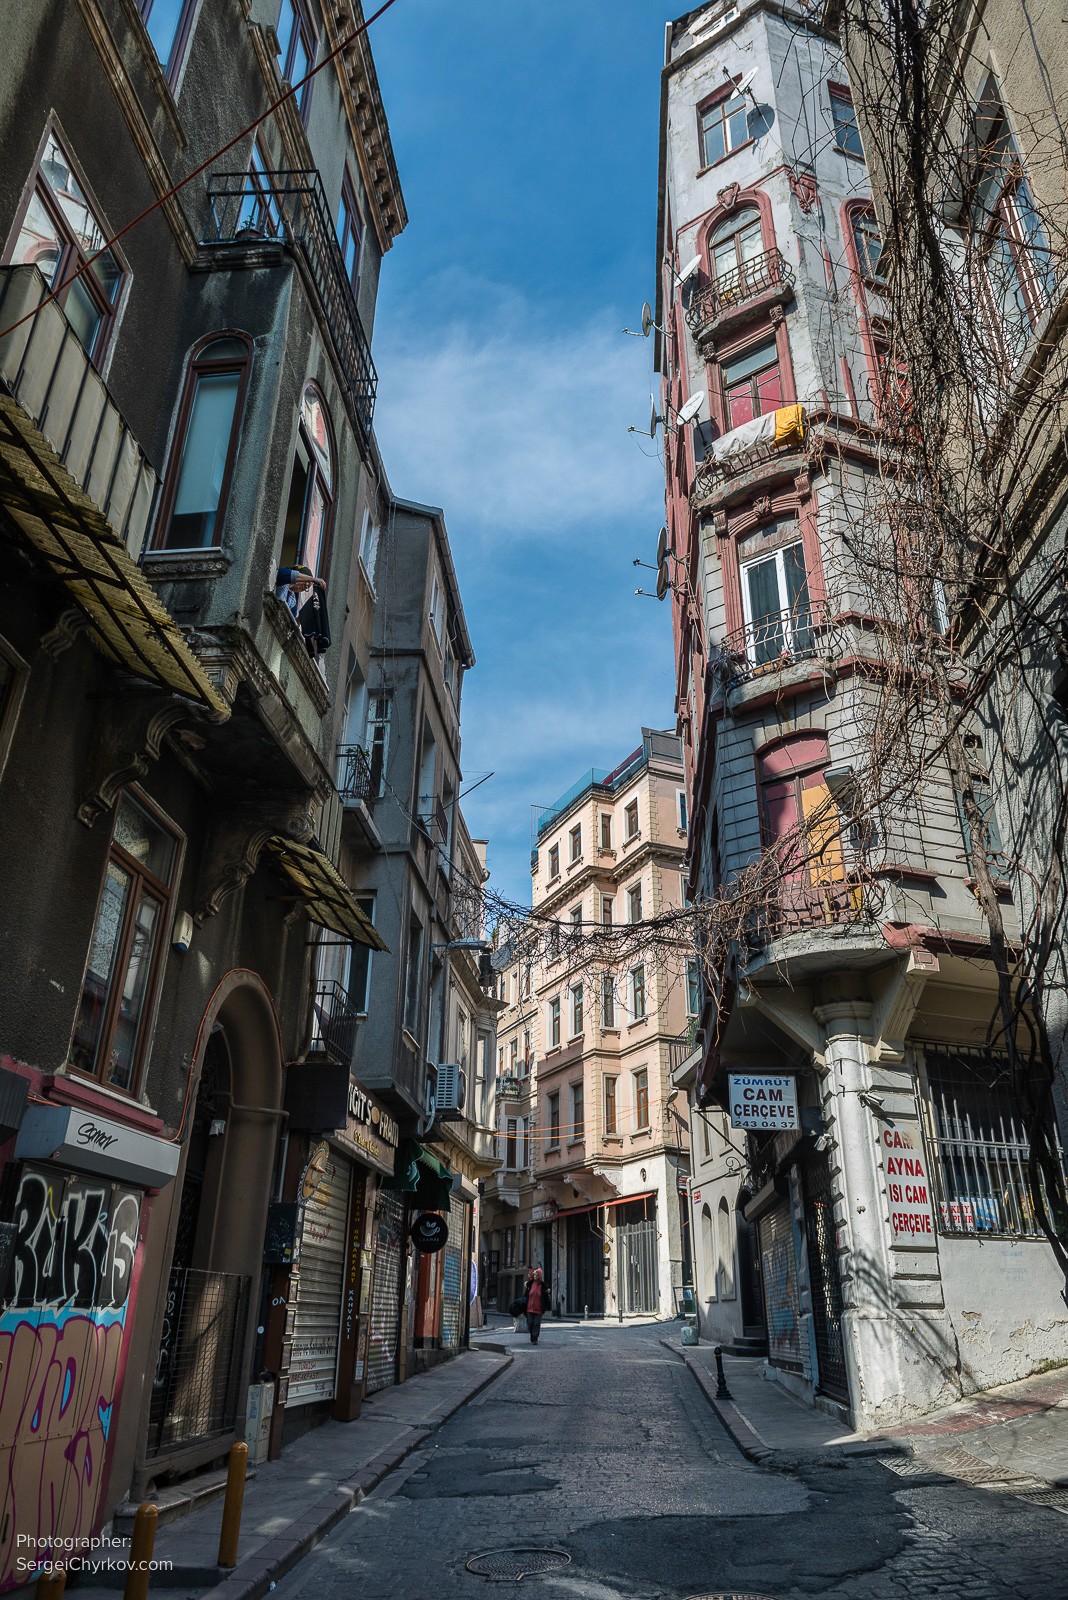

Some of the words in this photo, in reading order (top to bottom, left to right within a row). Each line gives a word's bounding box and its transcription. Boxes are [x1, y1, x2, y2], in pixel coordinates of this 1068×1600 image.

[733, 1077, 791, 1086] ZÜMRÜT
[743, 1088, 783, 1101] CAM
[734, 1104, 795, 1119] ÇERÇEVE
[887, 1157, 925, 1177] AYNA
[889, 1184, 903, 1202] ISI
[905, 1185, 928, 1204] CAM
[892, 1213, 931, 1236] ÇERÇEVE
